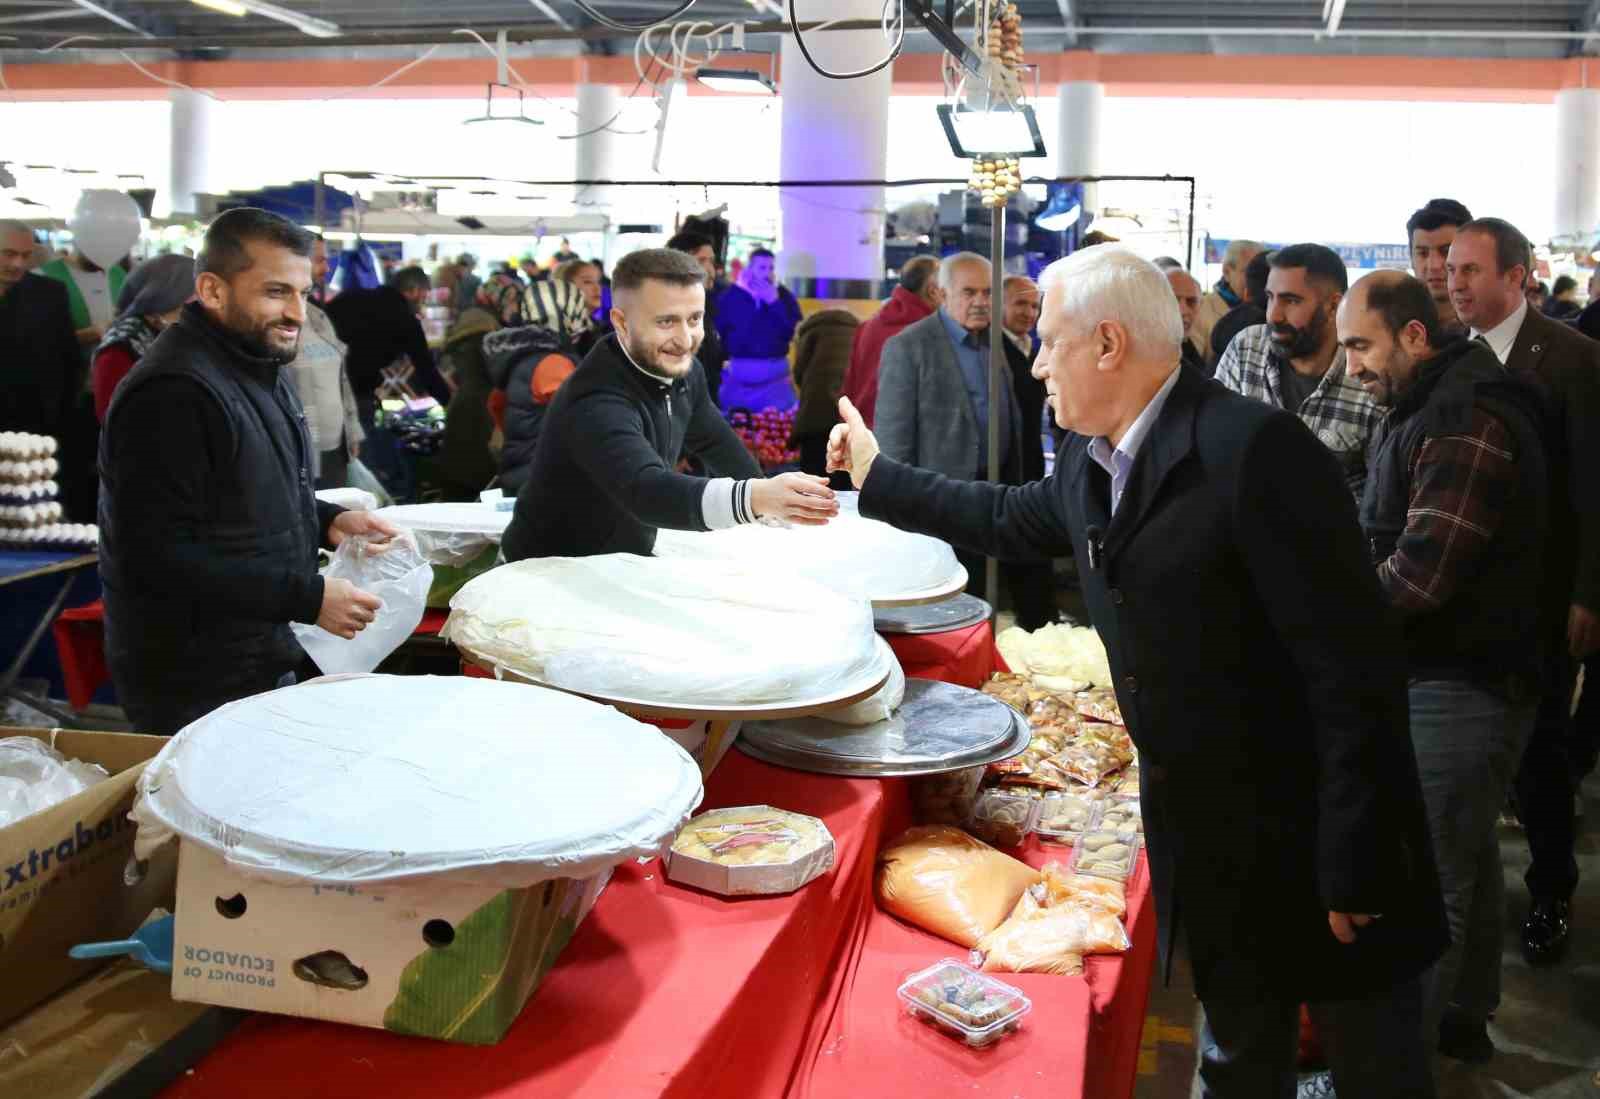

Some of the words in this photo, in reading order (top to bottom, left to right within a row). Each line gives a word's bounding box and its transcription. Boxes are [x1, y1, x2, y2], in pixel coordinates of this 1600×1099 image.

[0, 812, 126, 896] xtraba
[184, 944, 275, 972] ECUADOR
[184, 966, 202, 978] OF
[208, 968, 275, 988] PRODUCT
